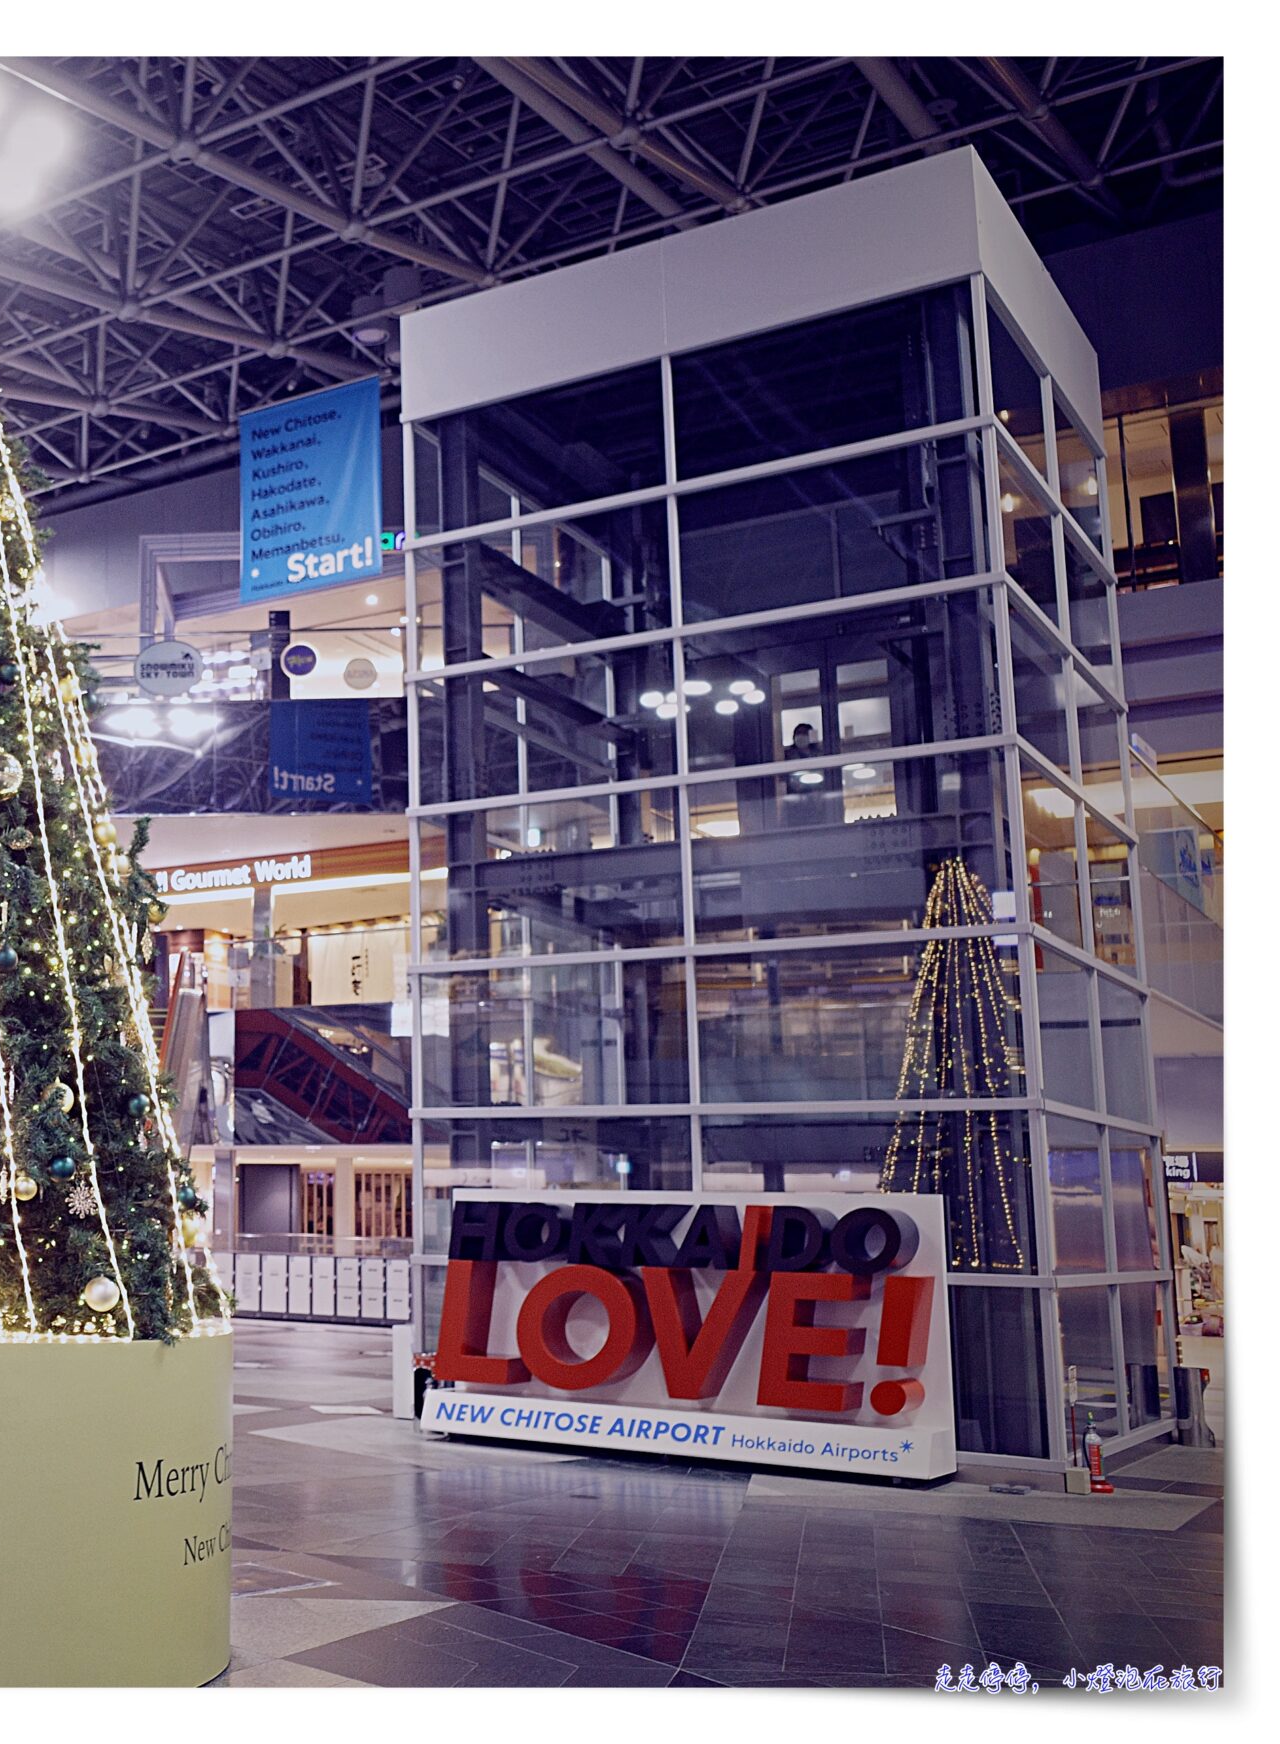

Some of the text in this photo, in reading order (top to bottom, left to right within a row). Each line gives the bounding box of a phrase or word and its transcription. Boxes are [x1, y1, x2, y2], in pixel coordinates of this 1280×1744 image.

[251, 408, 342, 443] New Chitose,
[251, 433, 322, 462] Wakkanai,
[251, 460, 309, 482] Kushiro,
[251, 475, 322, 502] Hakodate,
[251, 495, 330, 522] Asahikawa,
[250, 520, 307, 542] Obihiro,
[251, 532, 346, 563] Memanbetsu,
[287, 536, 374, 583] Start!
[170, 864, 252, 892] Gourmet
[254, 854, 312, 883] World
[448, 1200, 920, 1275] HOKKAIDO
[435, 1258, 936, 1417] LOVE!
[435, 1401, 900, 1464] NEW CHITOSE AIRPORT Hokkaido Airports
[133, 1458, 211, 1503] Merry
[184, 1535, 217, 1566] New
